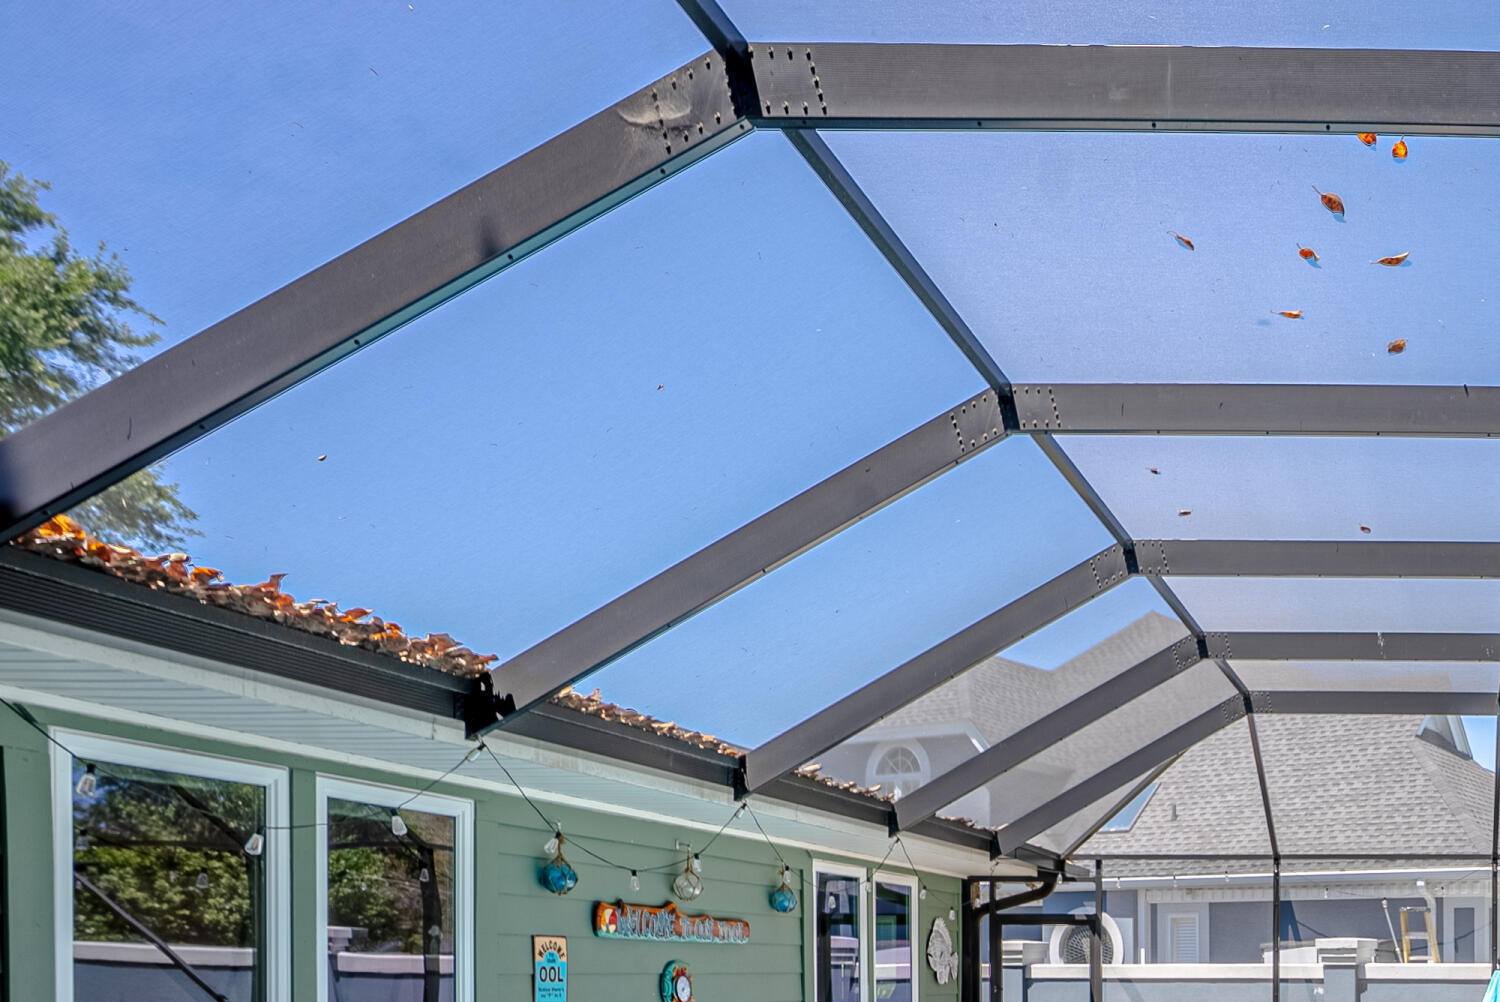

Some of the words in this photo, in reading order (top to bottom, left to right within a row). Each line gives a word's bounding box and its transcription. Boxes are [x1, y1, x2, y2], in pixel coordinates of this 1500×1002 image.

[617, 905, 676, 938] WELCOME
[538, 940, 565, 959] WELCOME
[539, 965, 564, 982] OOL
